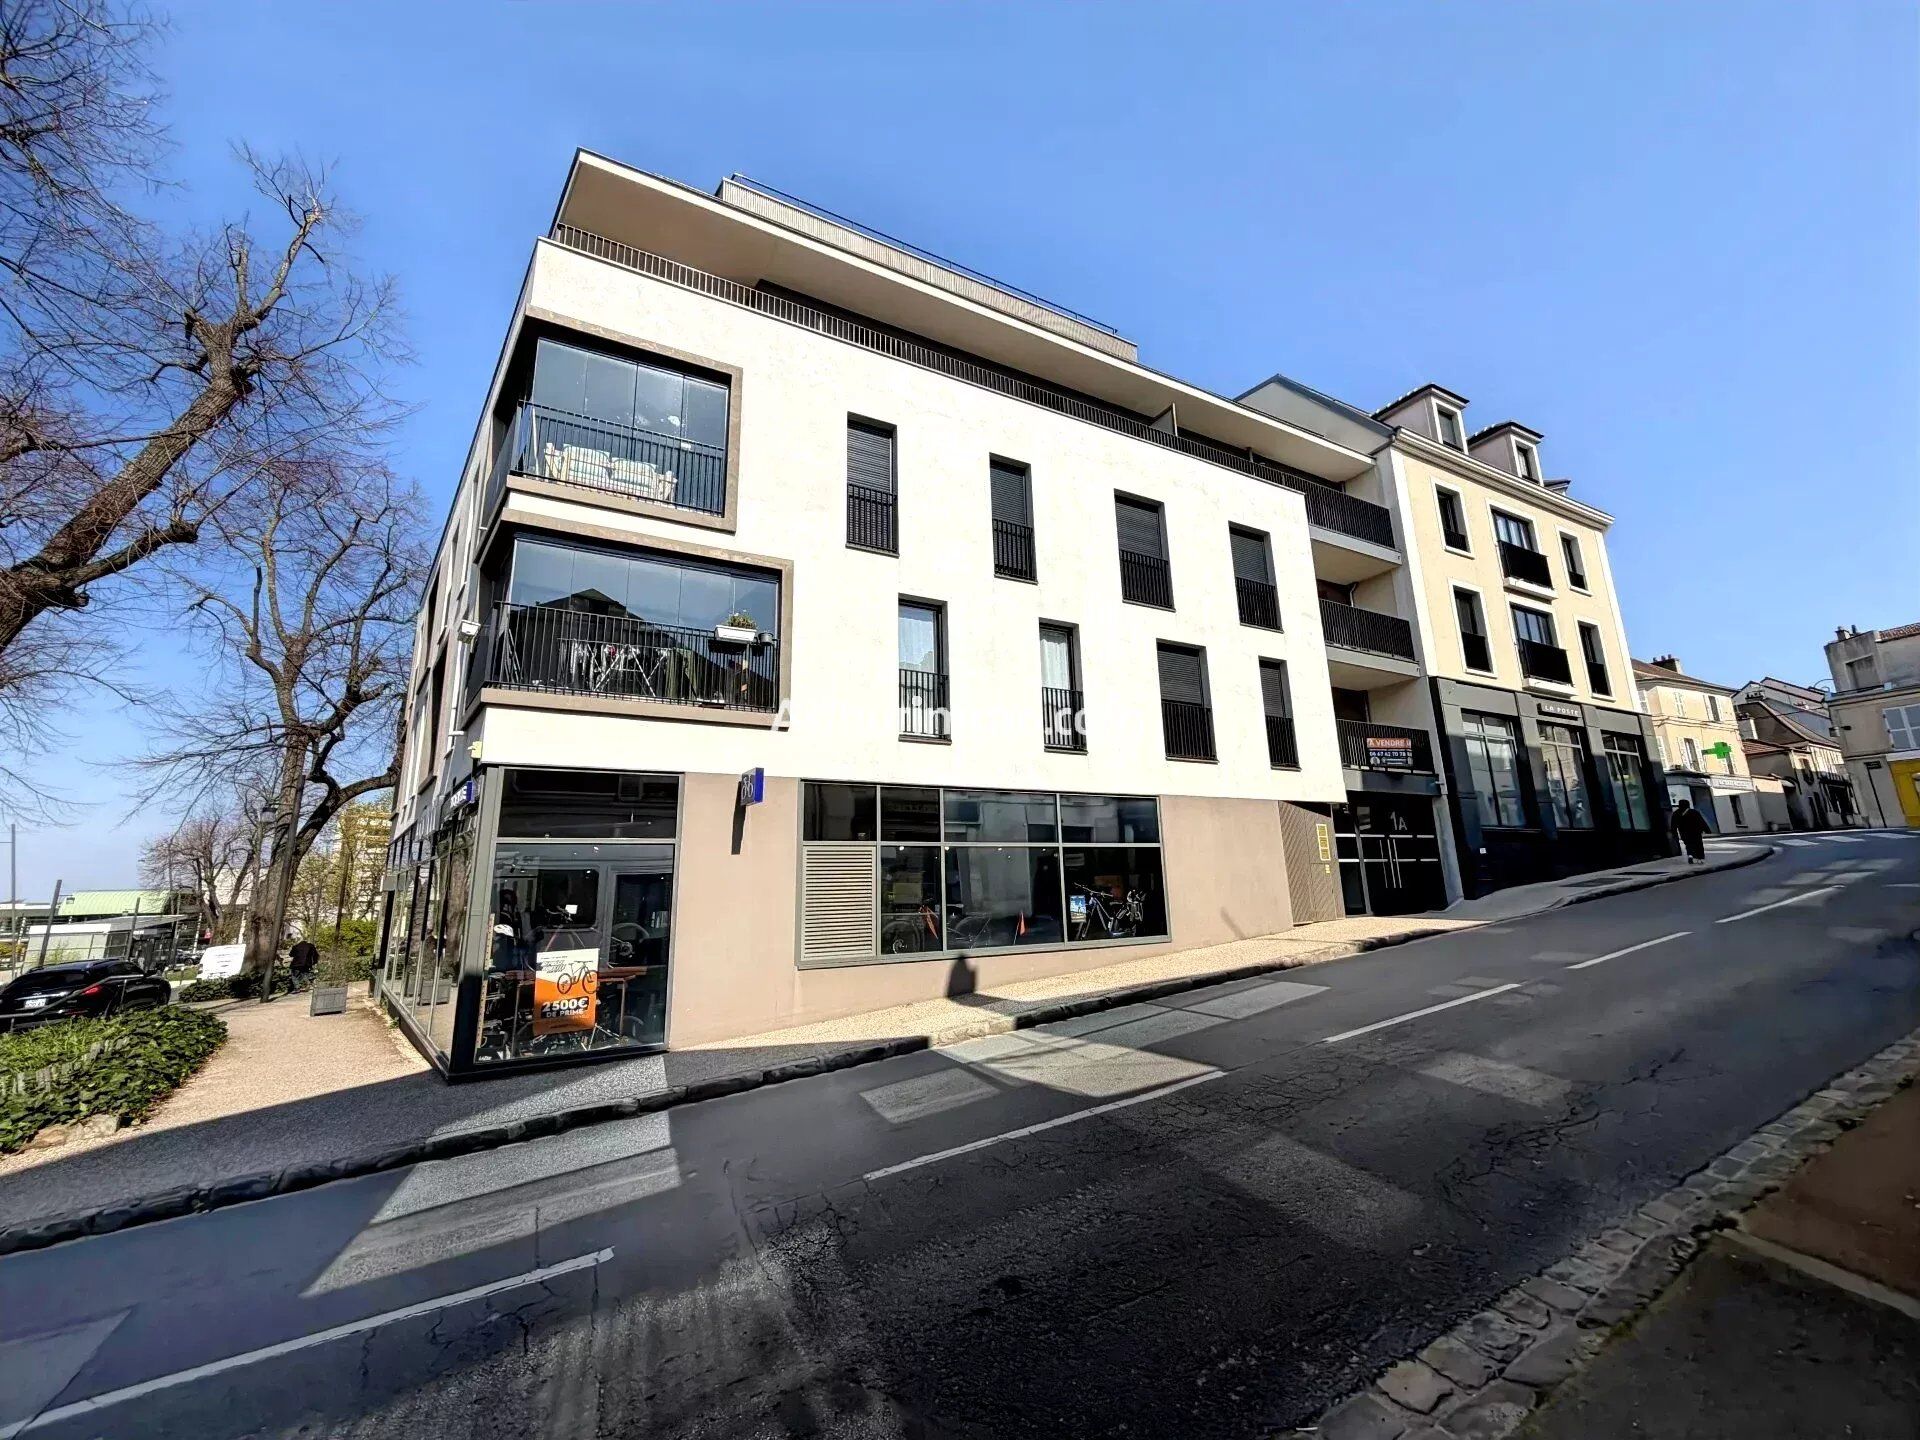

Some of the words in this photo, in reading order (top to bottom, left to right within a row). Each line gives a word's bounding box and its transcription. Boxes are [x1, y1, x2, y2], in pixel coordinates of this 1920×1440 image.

[1557, 707, 1579, 716] POSTE
[1375, 739, 1405, 748] VENDRE
[1390, 811, 1408, 831] 1A
[541, 997, 588, 1013] 2500€
[560, 1008, 584, 1017] PRIME
